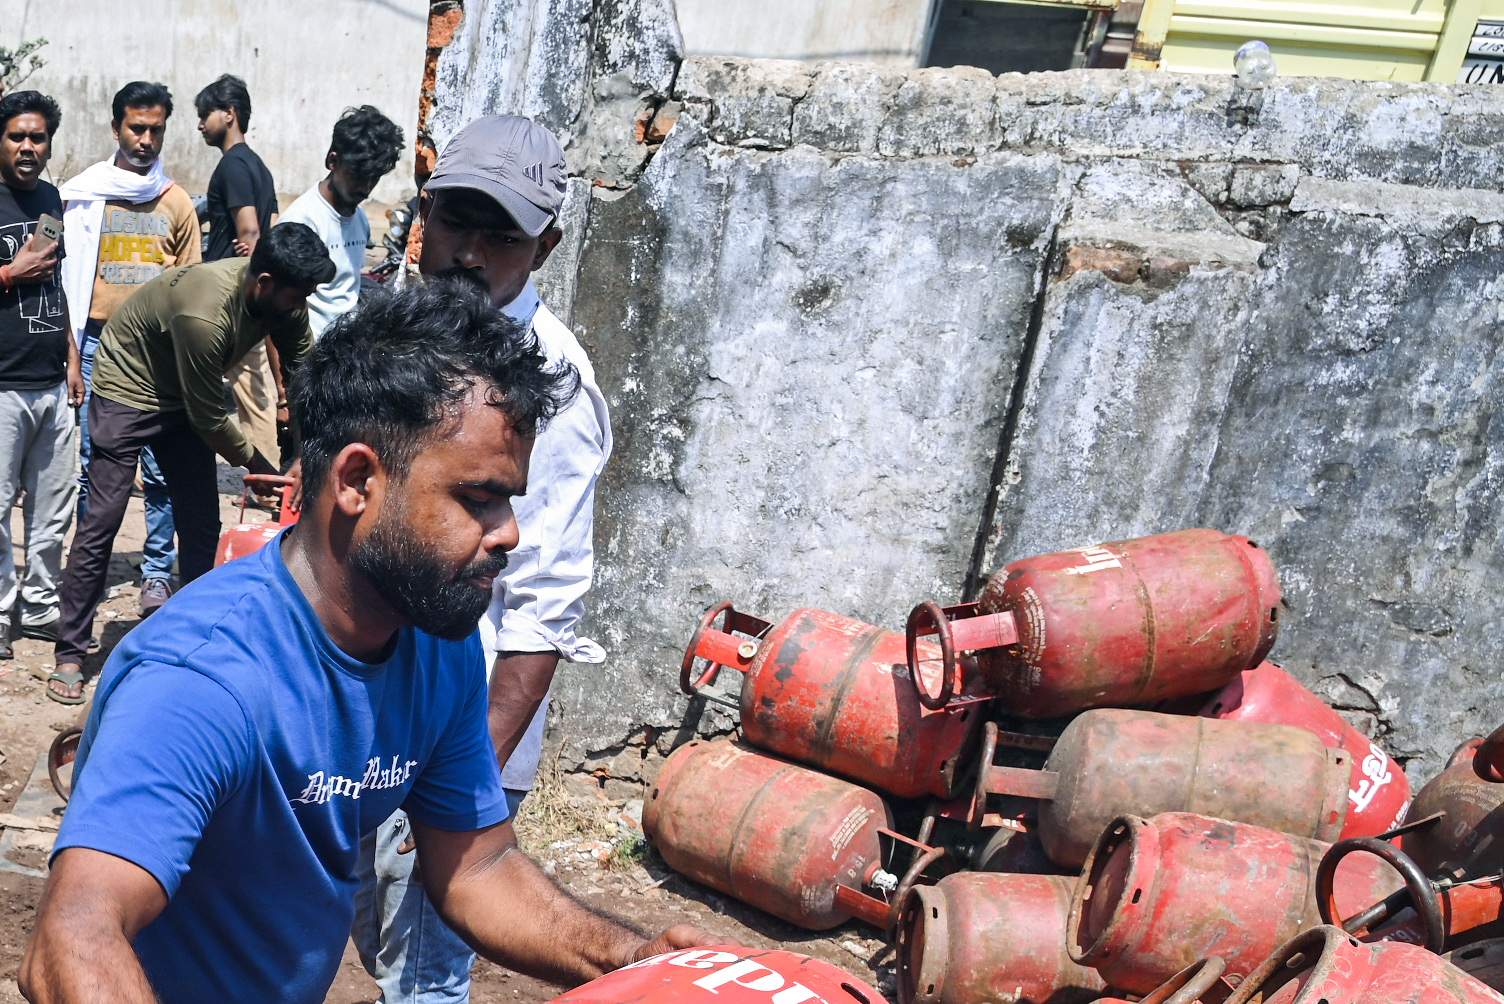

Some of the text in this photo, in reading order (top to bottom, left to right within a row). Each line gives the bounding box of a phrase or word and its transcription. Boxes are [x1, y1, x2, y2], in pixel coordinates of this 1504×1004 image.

[101, 210, 169, 238] LOSING
[101, 236, 153, 263] HOPE
[847, 853, 867, 879] 15.8
